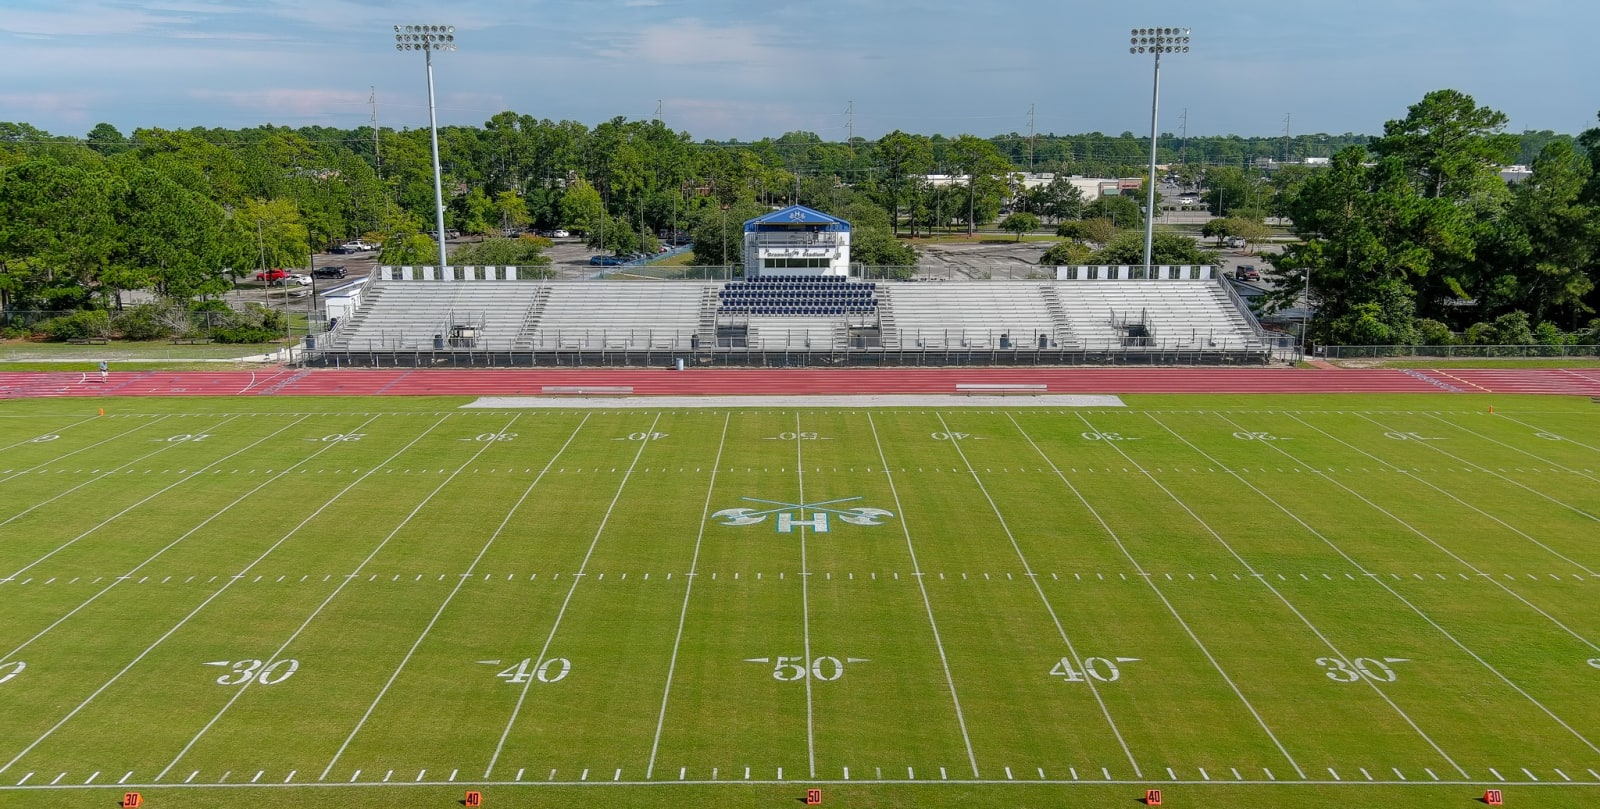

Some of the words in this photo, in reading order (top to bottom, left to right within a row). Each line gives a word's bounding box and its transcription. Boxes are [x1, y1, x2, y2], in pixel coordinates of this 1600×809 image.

[628, 431, 670, 441] 40
[779, 431, 818, 441] 50
[930, 431, 970, 441] 40
[776, 512, 830, 533] H
[216, 659, 299, 685] 30
[496, 657, 571, 684] 40
[772, 656, 844, 682] 50
[1049, 656, 1121, 683] 40
[1315, 656, 1397, 683] 30
[124, 793, 139, 806] 30
[466, 793, 479, 805] 40
[808, 790, 820, 803] 50
[1148, 790, 1160, 803] 40
[1488, 790, 1501, 803] 30
